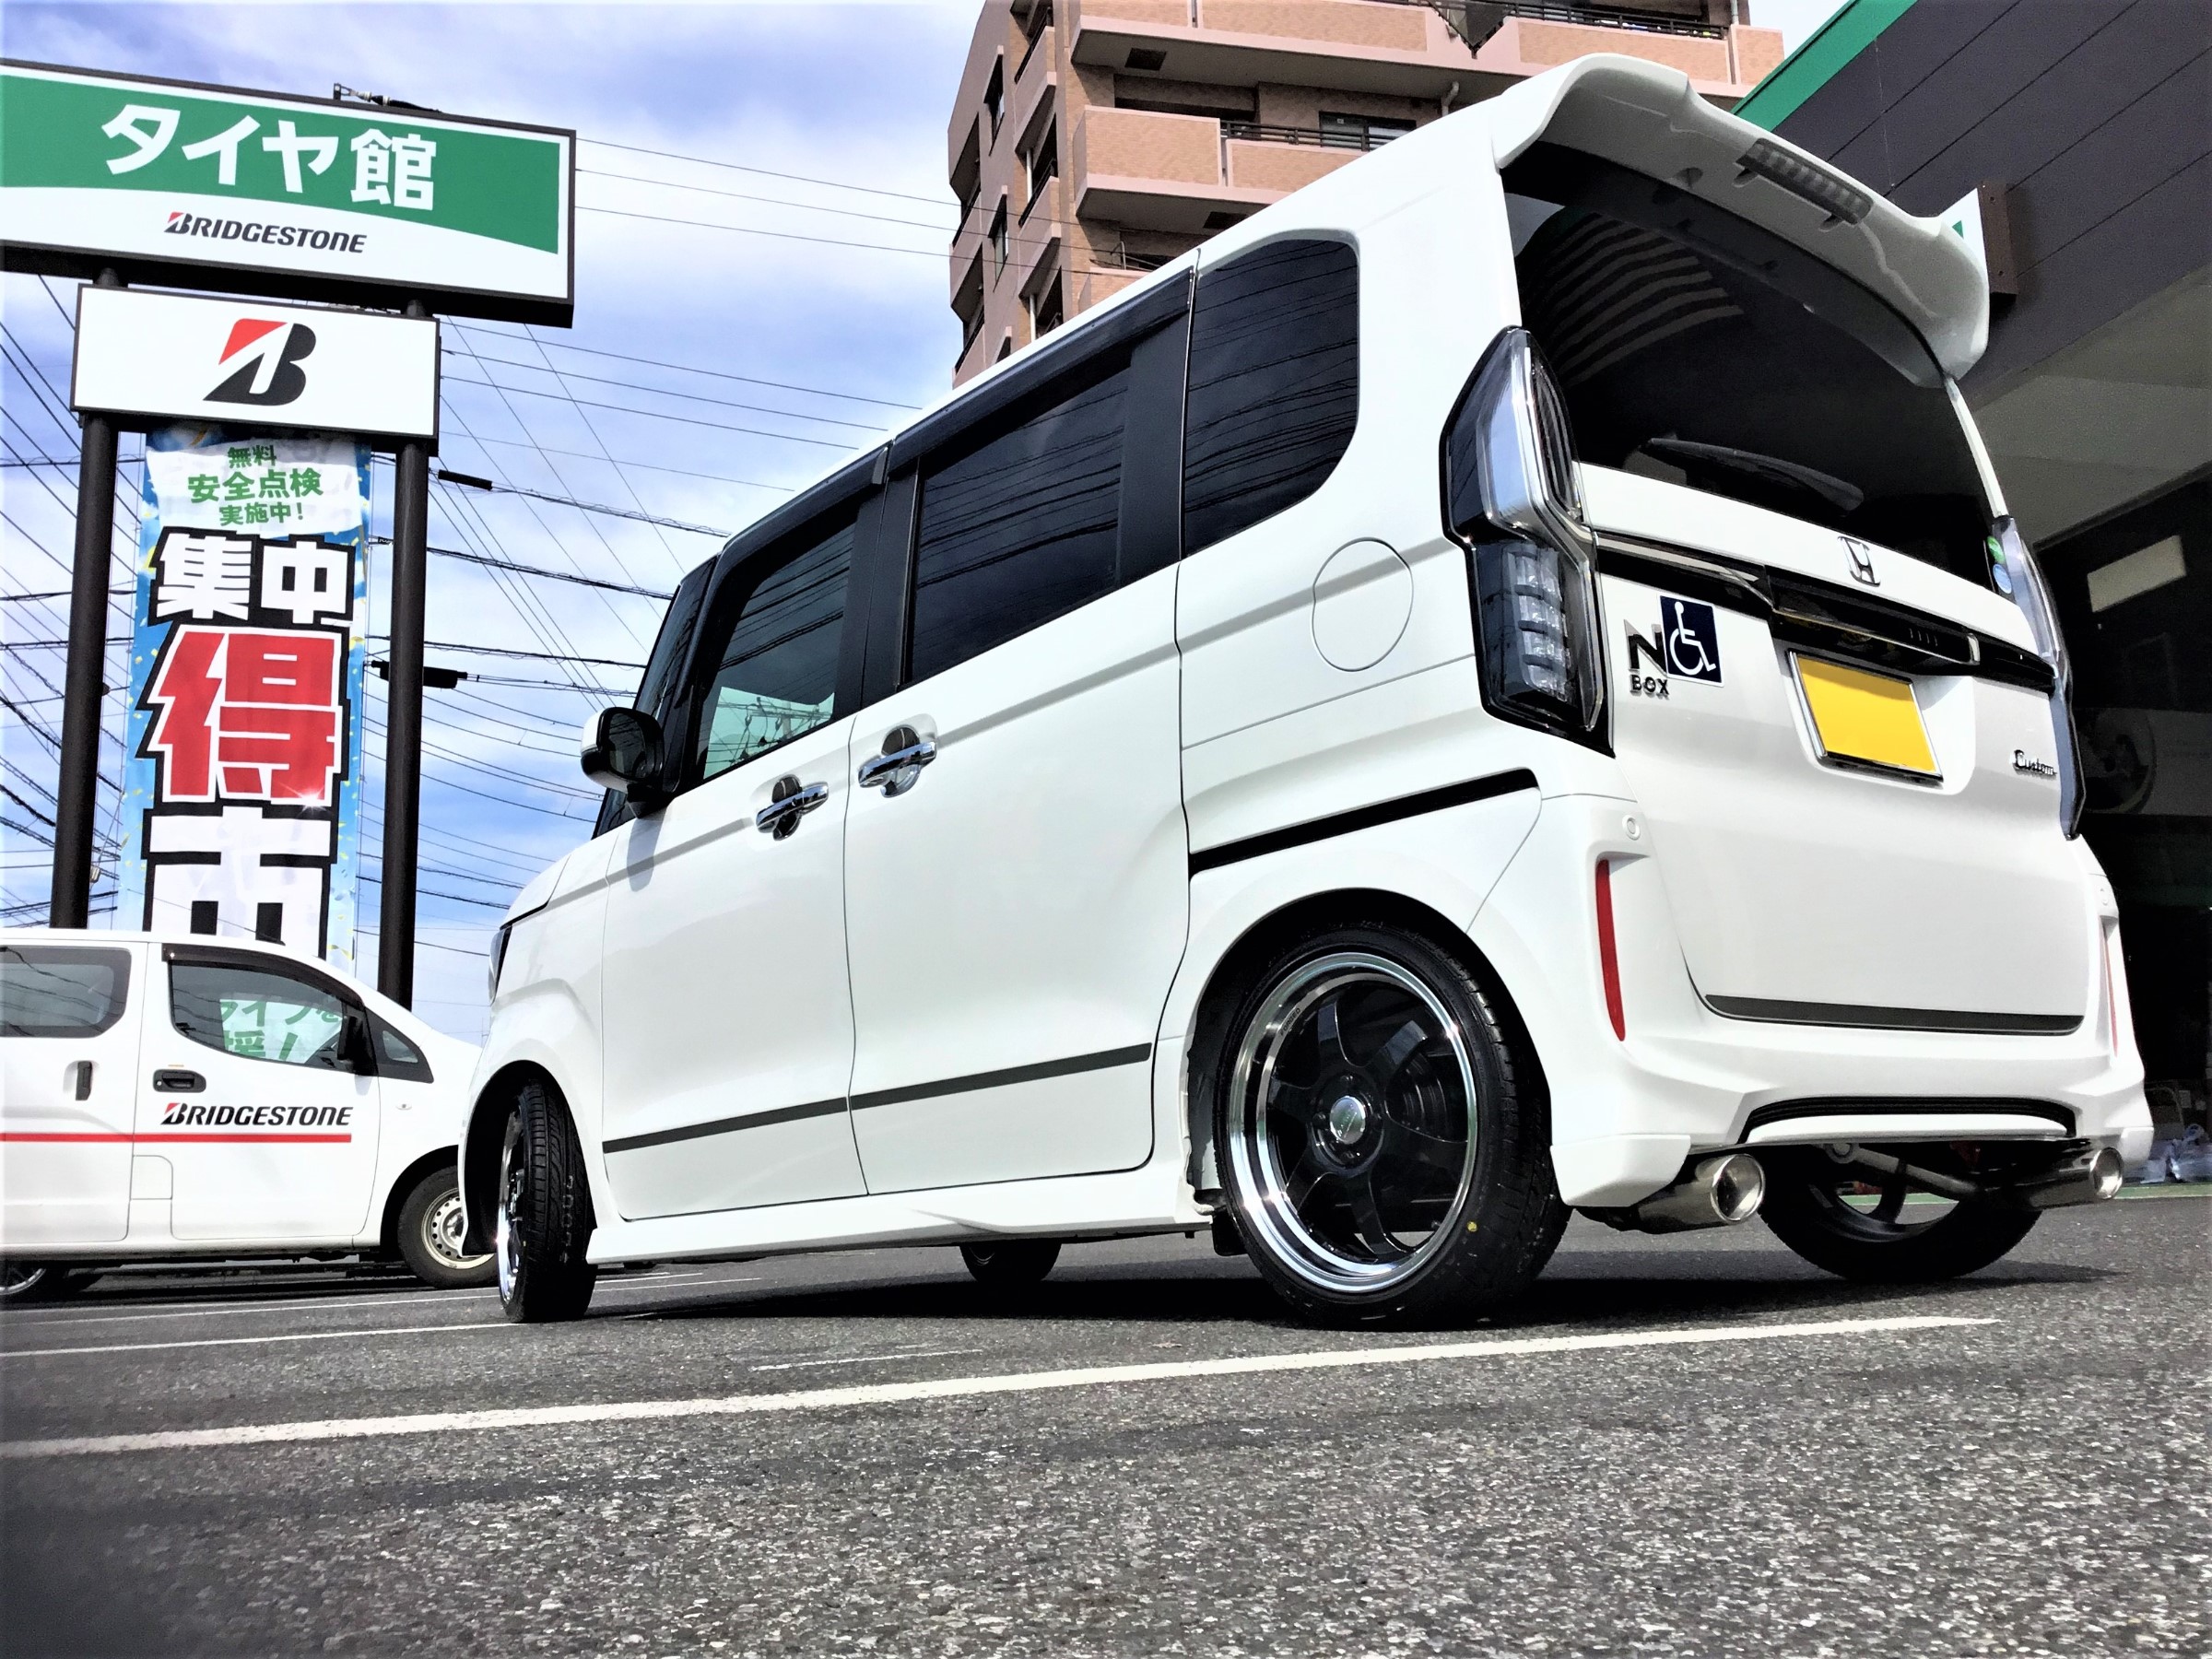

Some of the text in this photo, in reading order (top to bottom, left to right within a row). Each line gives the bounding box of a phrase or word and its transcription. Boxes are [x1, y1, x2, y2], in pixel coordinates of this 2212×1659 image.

[101, 103, 437, 211] タイヤ館
[164, 211, 368, 253] BRIDGESTONE
[227, 444, 276, 468] 無料
[187, 467, 324, 503] 安全点検
[154, 530, 351, 625] 集中
[1630, 674, 1669, 699] BOX
[147, 624, 342, 806] 得
[2012, 749, 2057, 778] Custom
[149, 806, 331, 957] 市
[160, 1102, 353, 1126] BRIDGESTONE
